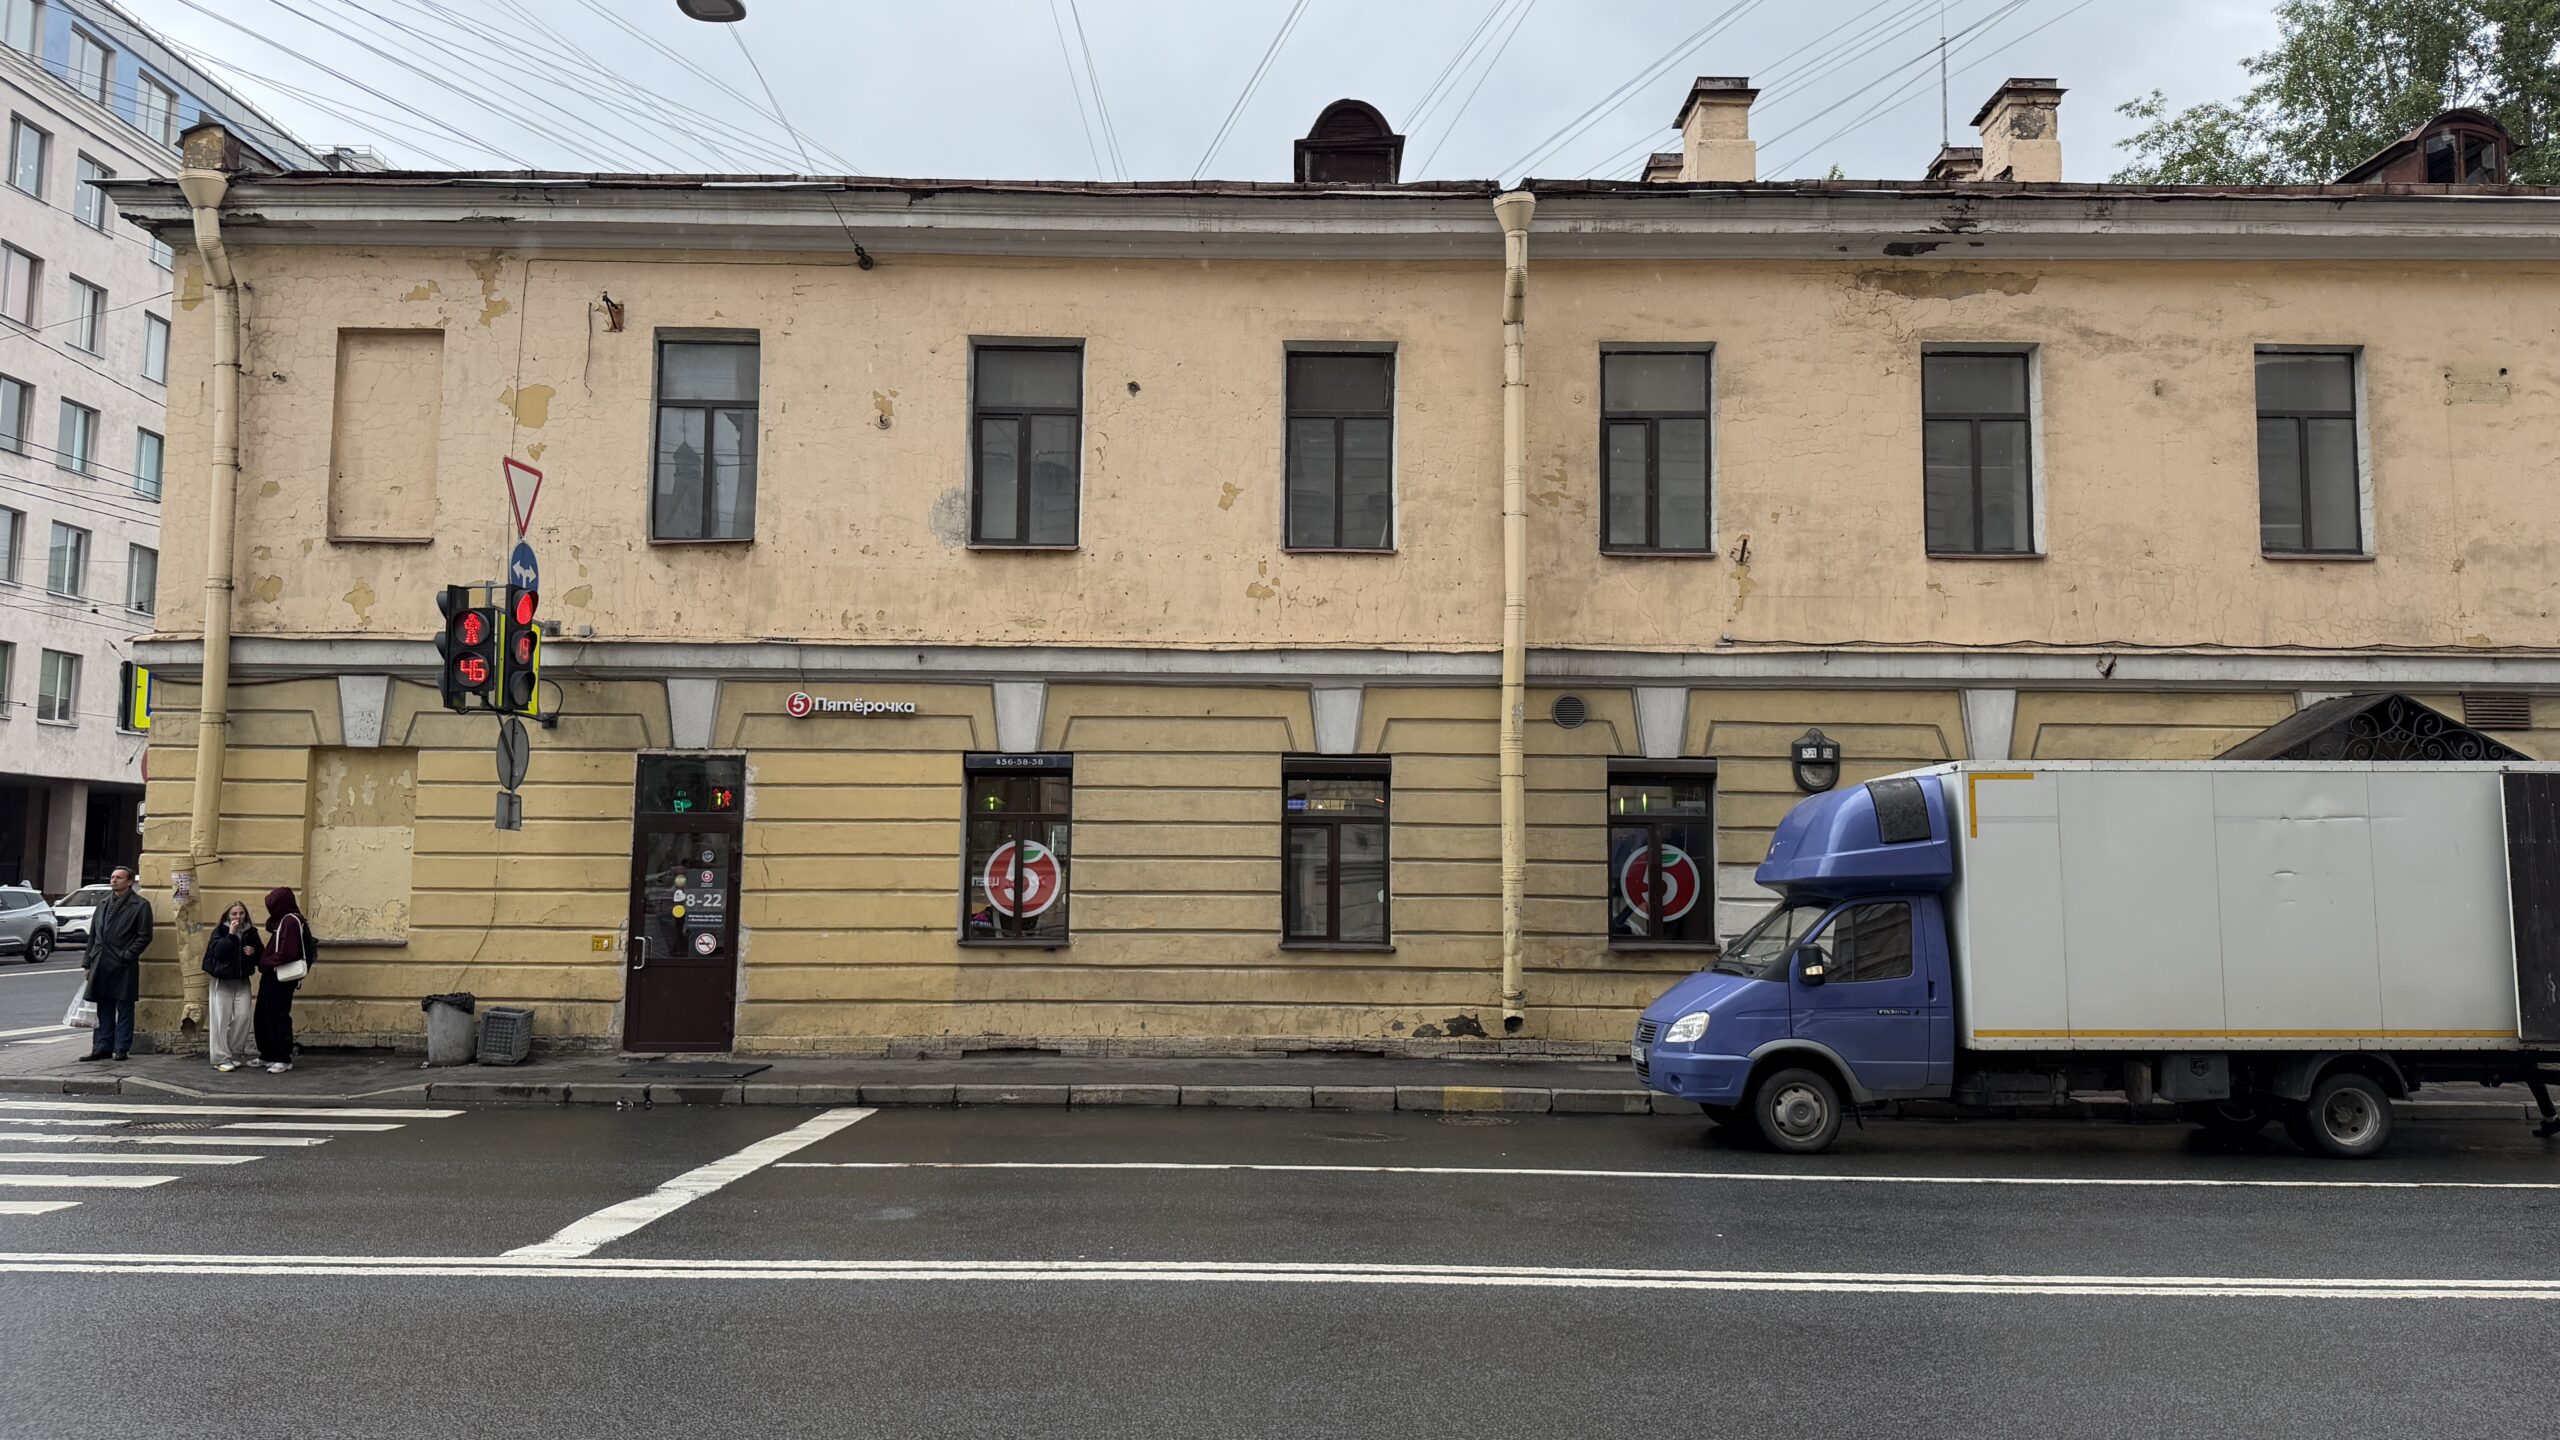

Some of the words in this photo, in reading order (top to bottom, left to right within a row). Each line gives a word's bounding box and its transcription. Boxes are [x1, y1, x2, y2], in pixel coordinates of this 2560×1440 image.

[460, 659, 486, 682] 46
[815, 697, 916, 715] Пятёрочка
[995, 758, 1044, 767] 456-58-38
[1642, 851, 1682, 906] 5
[686, 893, 722, 907] 8-22
